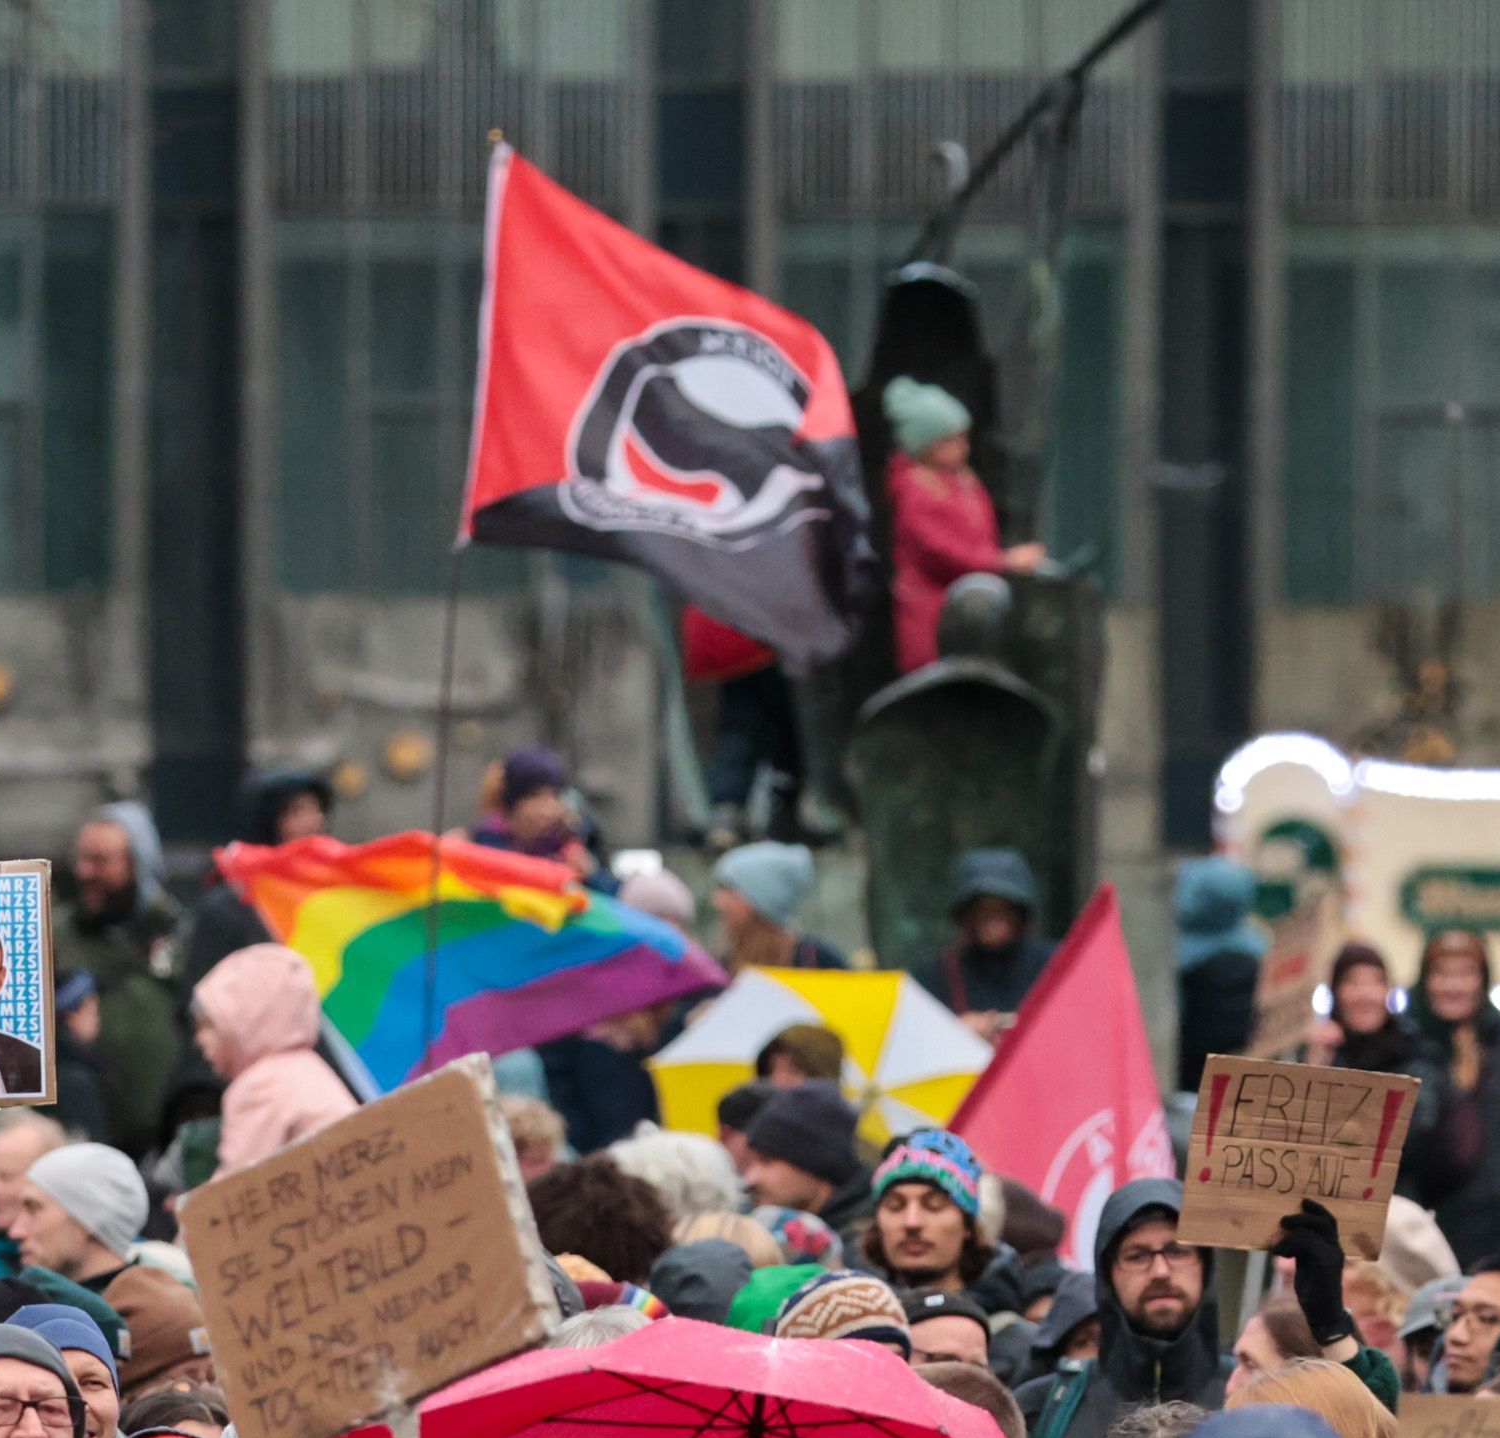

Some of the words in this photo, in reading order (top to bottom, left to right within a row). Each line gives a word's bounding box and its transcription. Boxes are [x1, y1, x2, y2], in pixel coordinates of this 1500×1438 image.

[1230, 1073, 1373, 1147] FRITZ
[1220, 1144, 1299, 1195] PASS
[1302, 1155, 1361, 1199] AUF
[227, 1223, 428, 1348] WELTBILD
[241, 1346, 296, 1391] UND
[309, 1317, 358, 1361] DAS
